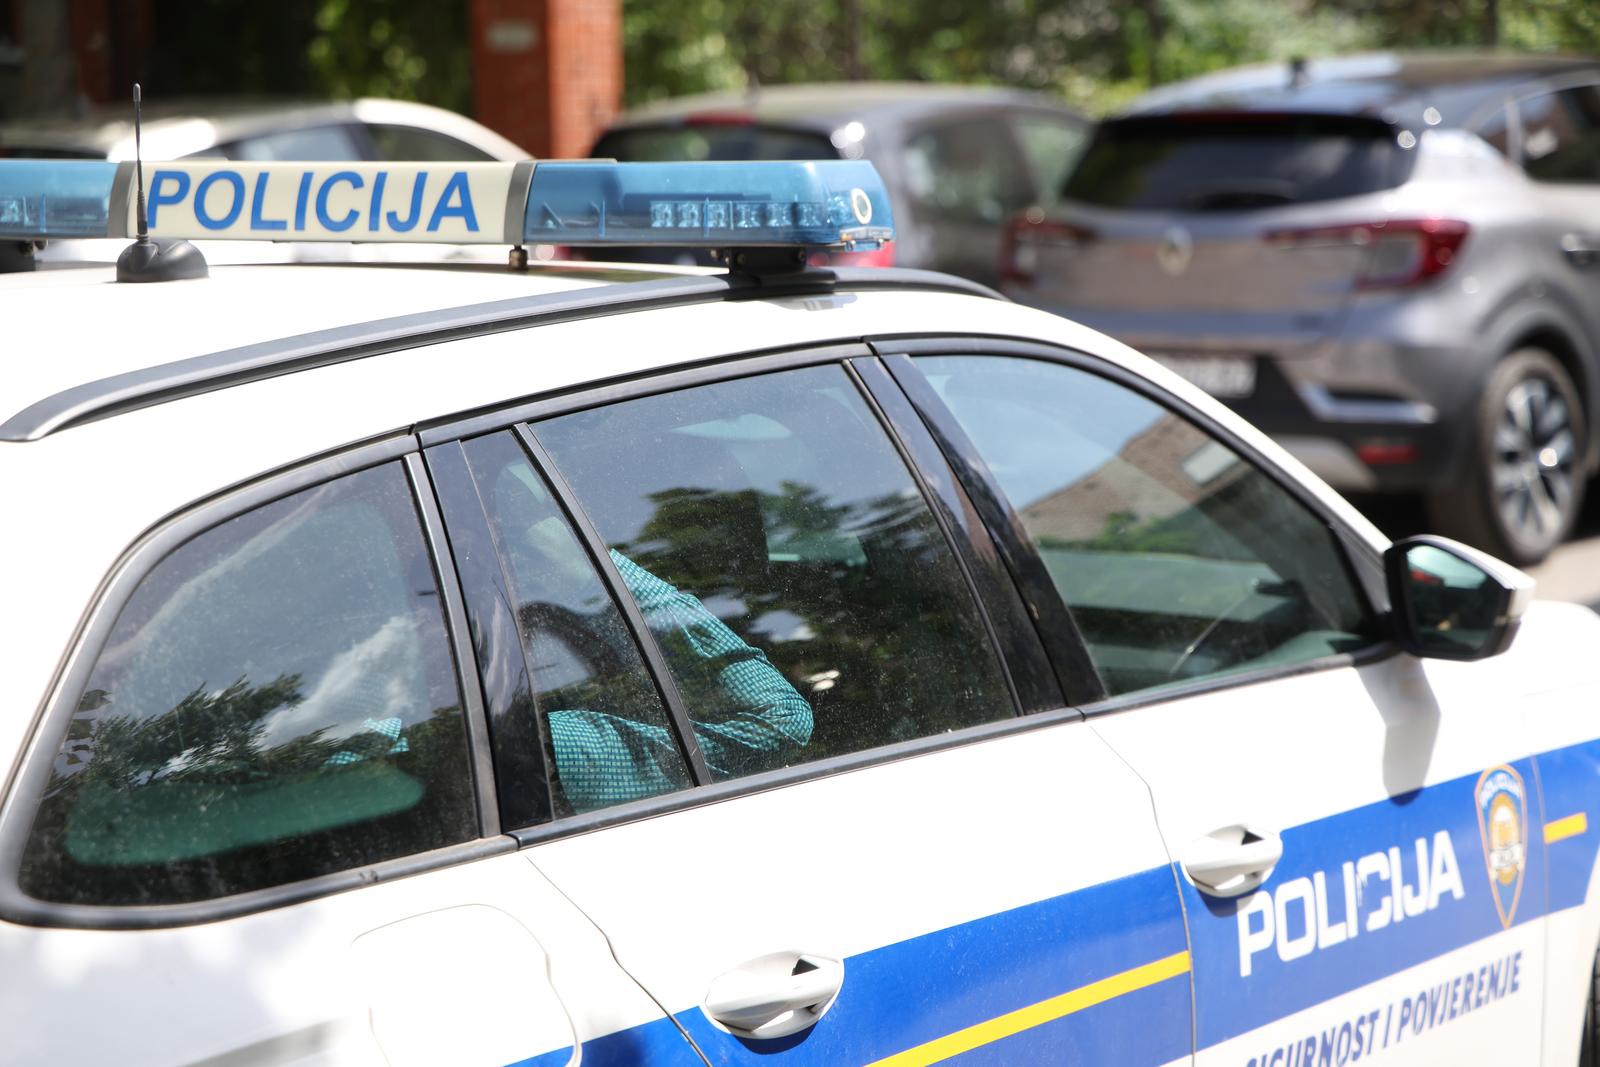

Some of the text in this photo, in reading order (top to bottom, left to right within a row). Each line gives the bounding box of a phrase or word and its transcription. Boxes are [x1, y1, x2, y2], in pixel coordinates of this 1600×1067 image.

[147, 170, 479, 232] POLICIJA
[1237, 830, 1464, 977] POLICIJA
[1383, 1003, 1393, 1049] I
[1396, 950, 1522, 1043] POVJERENJE
